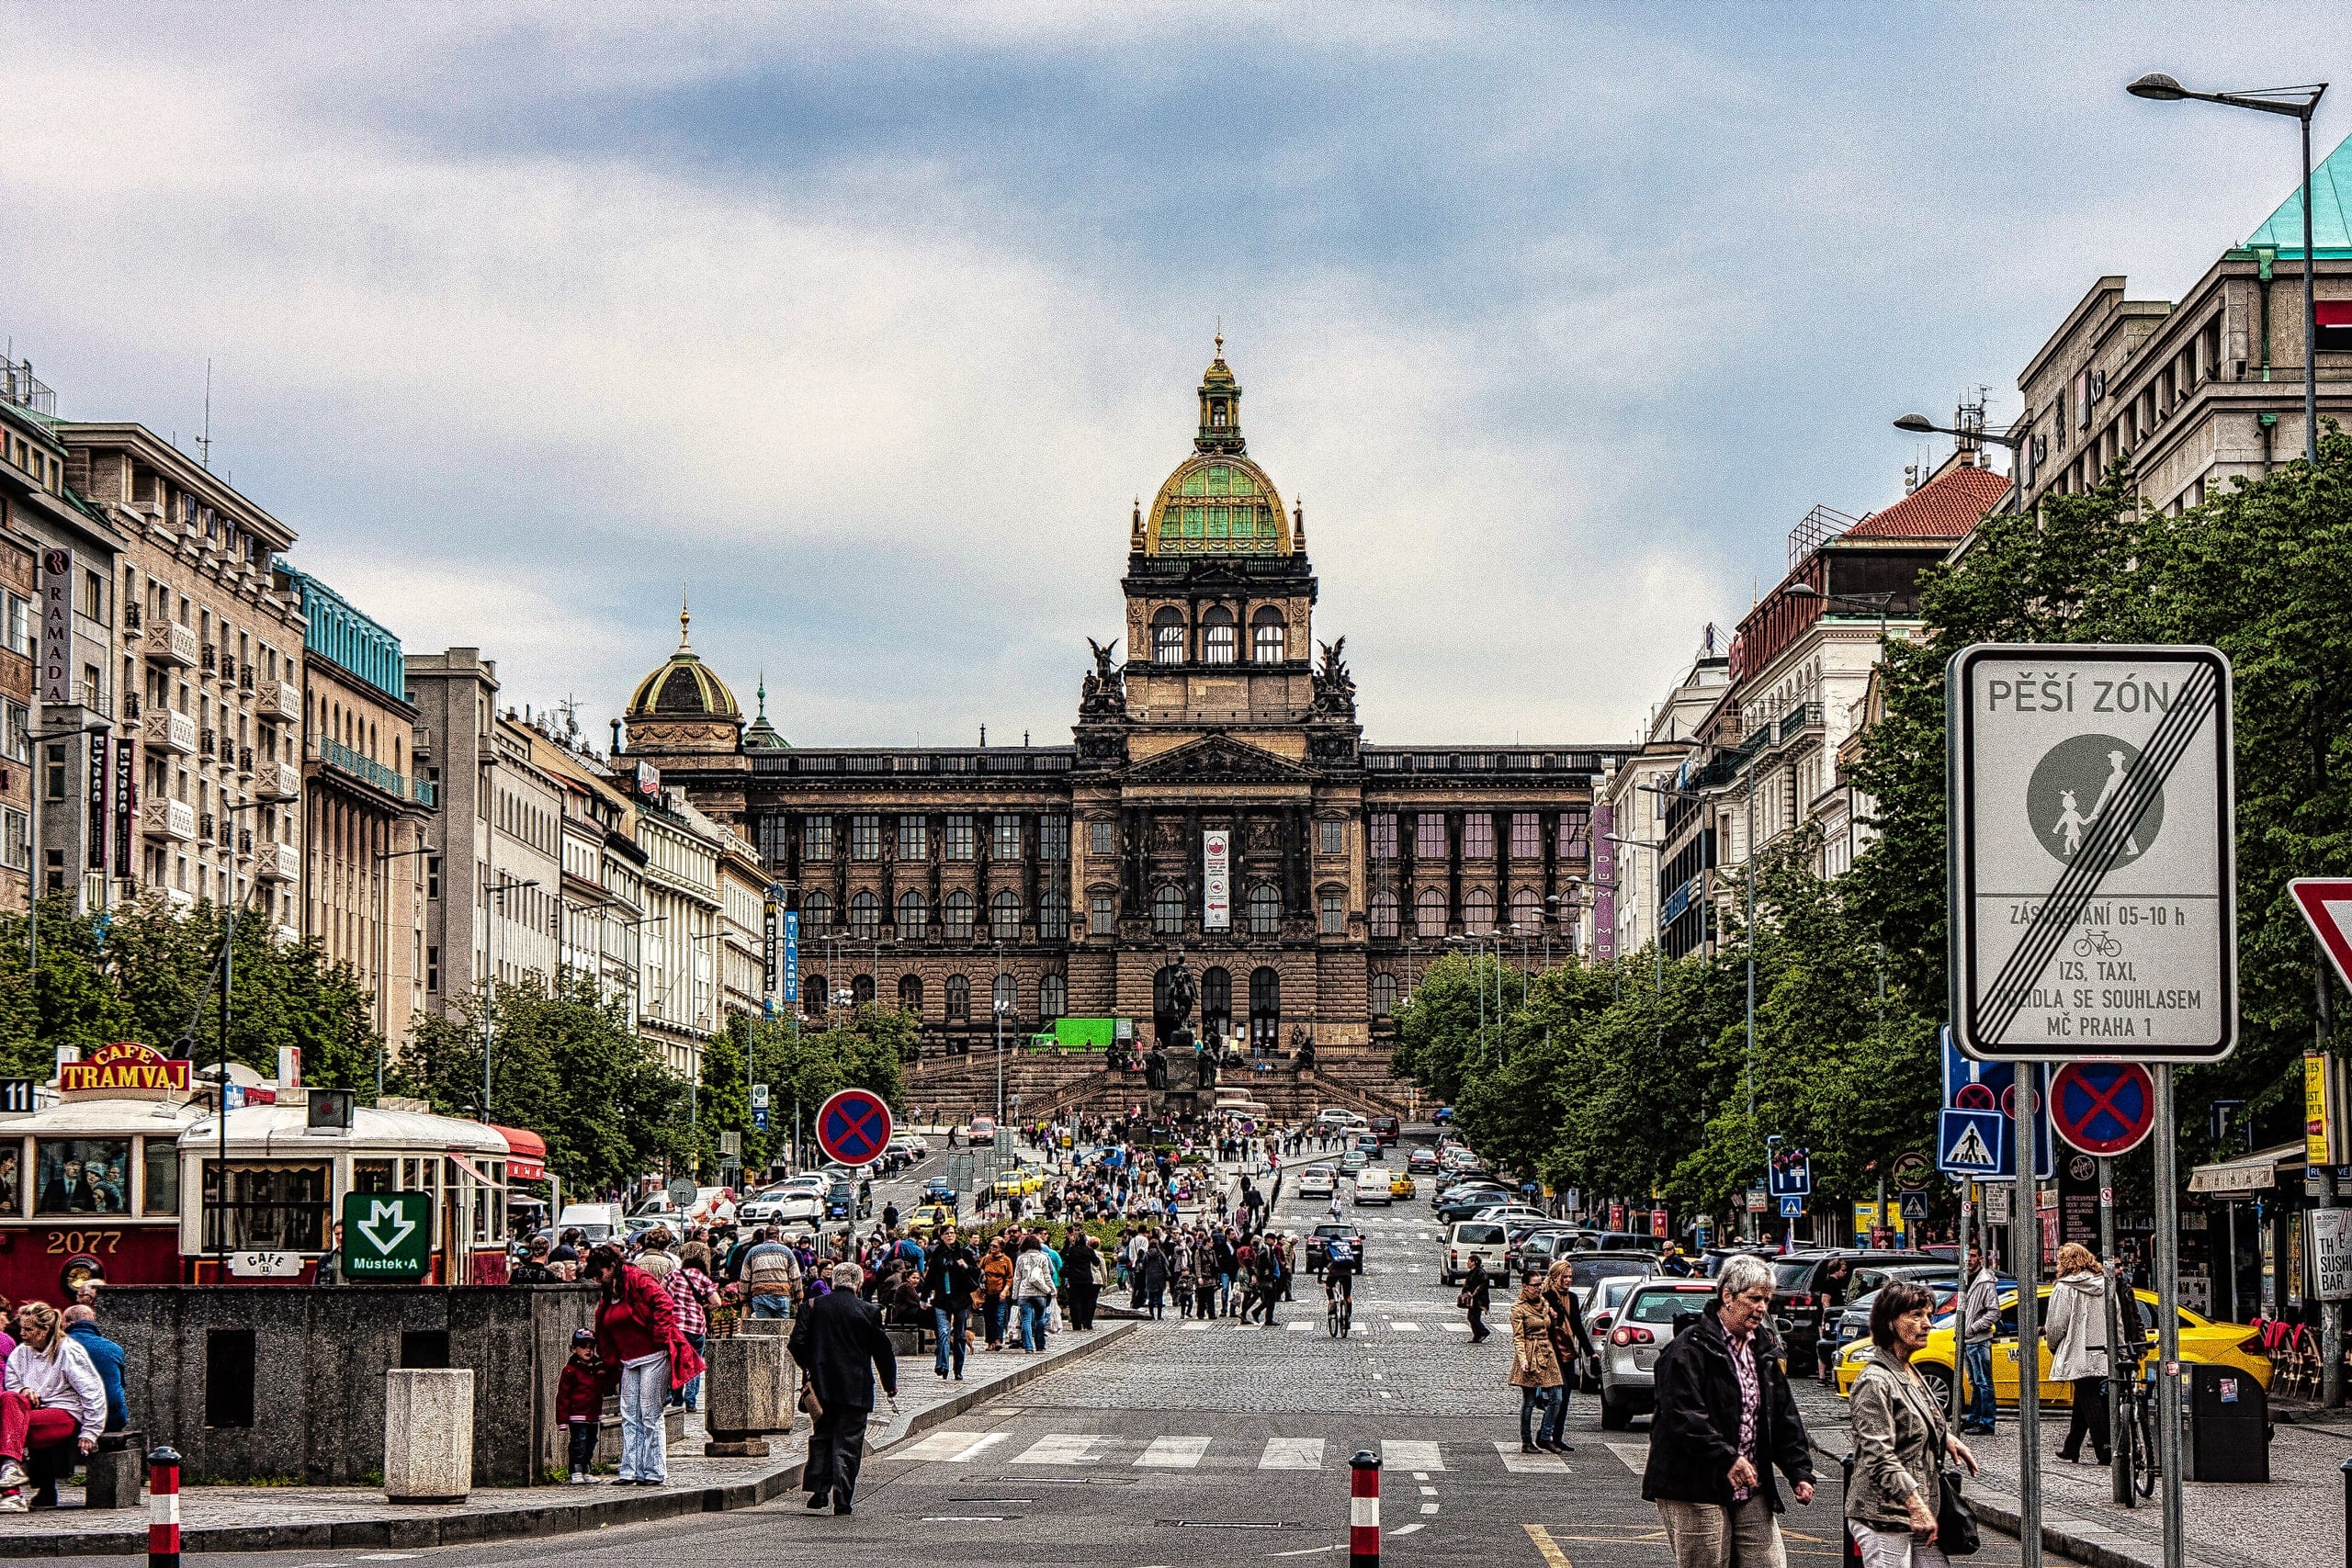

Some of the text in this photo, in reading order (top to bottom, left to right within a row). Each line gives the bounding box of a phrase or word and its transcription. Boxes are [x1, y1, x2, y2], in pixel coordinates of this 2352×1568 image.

[2090, 370, 2103, 406] KB
[2033, 434, 2044, 468] KB
[47, 586, 63, 699] RAMADA
[1988, 671, 2079, 713] PĚŠÍ
[90, 735, 105, 802] Elysee
[117, 747, 130, 813] Elysee
[2010, 901, 2112, 926] ZÁSÁNÍ
[2175, 906, 2185, 926] h
[2059, 961, 2137, 983] IZS, TAXI,
[2074, 988, 2094, 1009] SE
[2102, 989, 2201, 1010] SOUHLASEM
[2047, 1011, 2152, 1037] MČ PRAHA 1
[94, 1044, 155, 1066] CAFE
[63, 1066, 186, 1090] TRAMVAJ
[5, 1081, 29, 1111] 11
[46, 1231, 121, 1254] 2077
[246, 1252, 285, 1268] CAFE
[2321, 1273, 2347, 1292] BAR.
